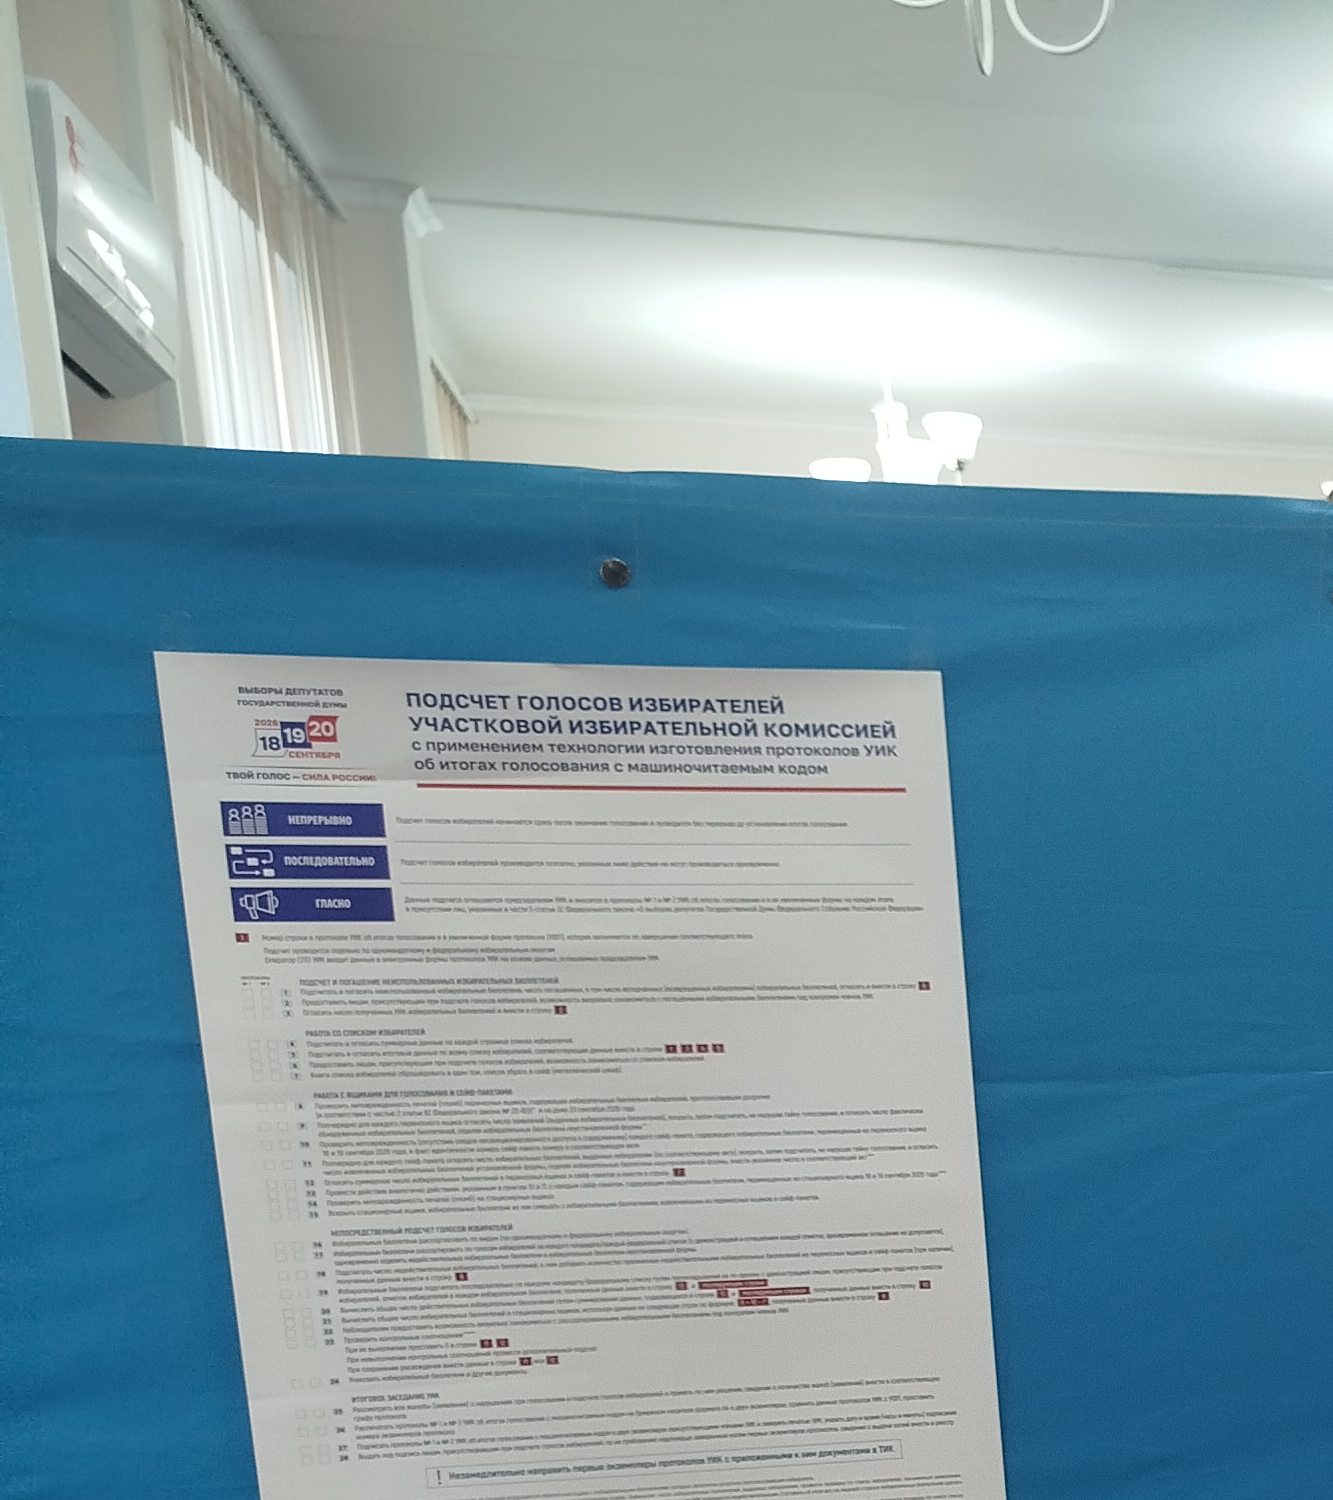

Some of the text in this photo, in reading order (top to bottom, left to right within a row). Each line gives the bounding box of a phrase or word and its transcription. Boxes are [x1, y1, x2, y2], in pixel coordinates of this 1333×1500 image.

[238, 686, 343, 697] ВЫБОРЫ ДЕПУТАТОВ
[237, 699, 348, 709] ГОСУДАРСТВЕННОЙ ДУМЫ
[406, 692, 785, 714] ПОДСЧЕТ ГОЛОСОВ ИЗБИРАТЕЛЕЙ
[409, 716, 897, 739] УЧАСТКОВОЙ ИЗБИРАТЕЛЬНОЙ КОМИССИЕЙ
[259, 721, 334, 751] 18 19 20
[288, 751, 341, 759] СЕНТЯБРЯ
[412, 741, 898, 759] с применением технологии изготовления протоколов УИК
[414, 758, 829, 776] об итогах голосования с машиночитаемым кодом
[226, 770, 254, 780] ТВОЙ
[256, 772, 291, 781] ГОЛОС
[302, 773, 330, 782] СИЛА
[332, 774, 377, 782] РОССИИ!
[288, 815, 353, 826] НЕПРЕРЫВНО
[284, 856, 375, 868] ПОСЛЕДОВАТЕЛЬНО
[315, 898, 351, 909] ГЛАСНО
